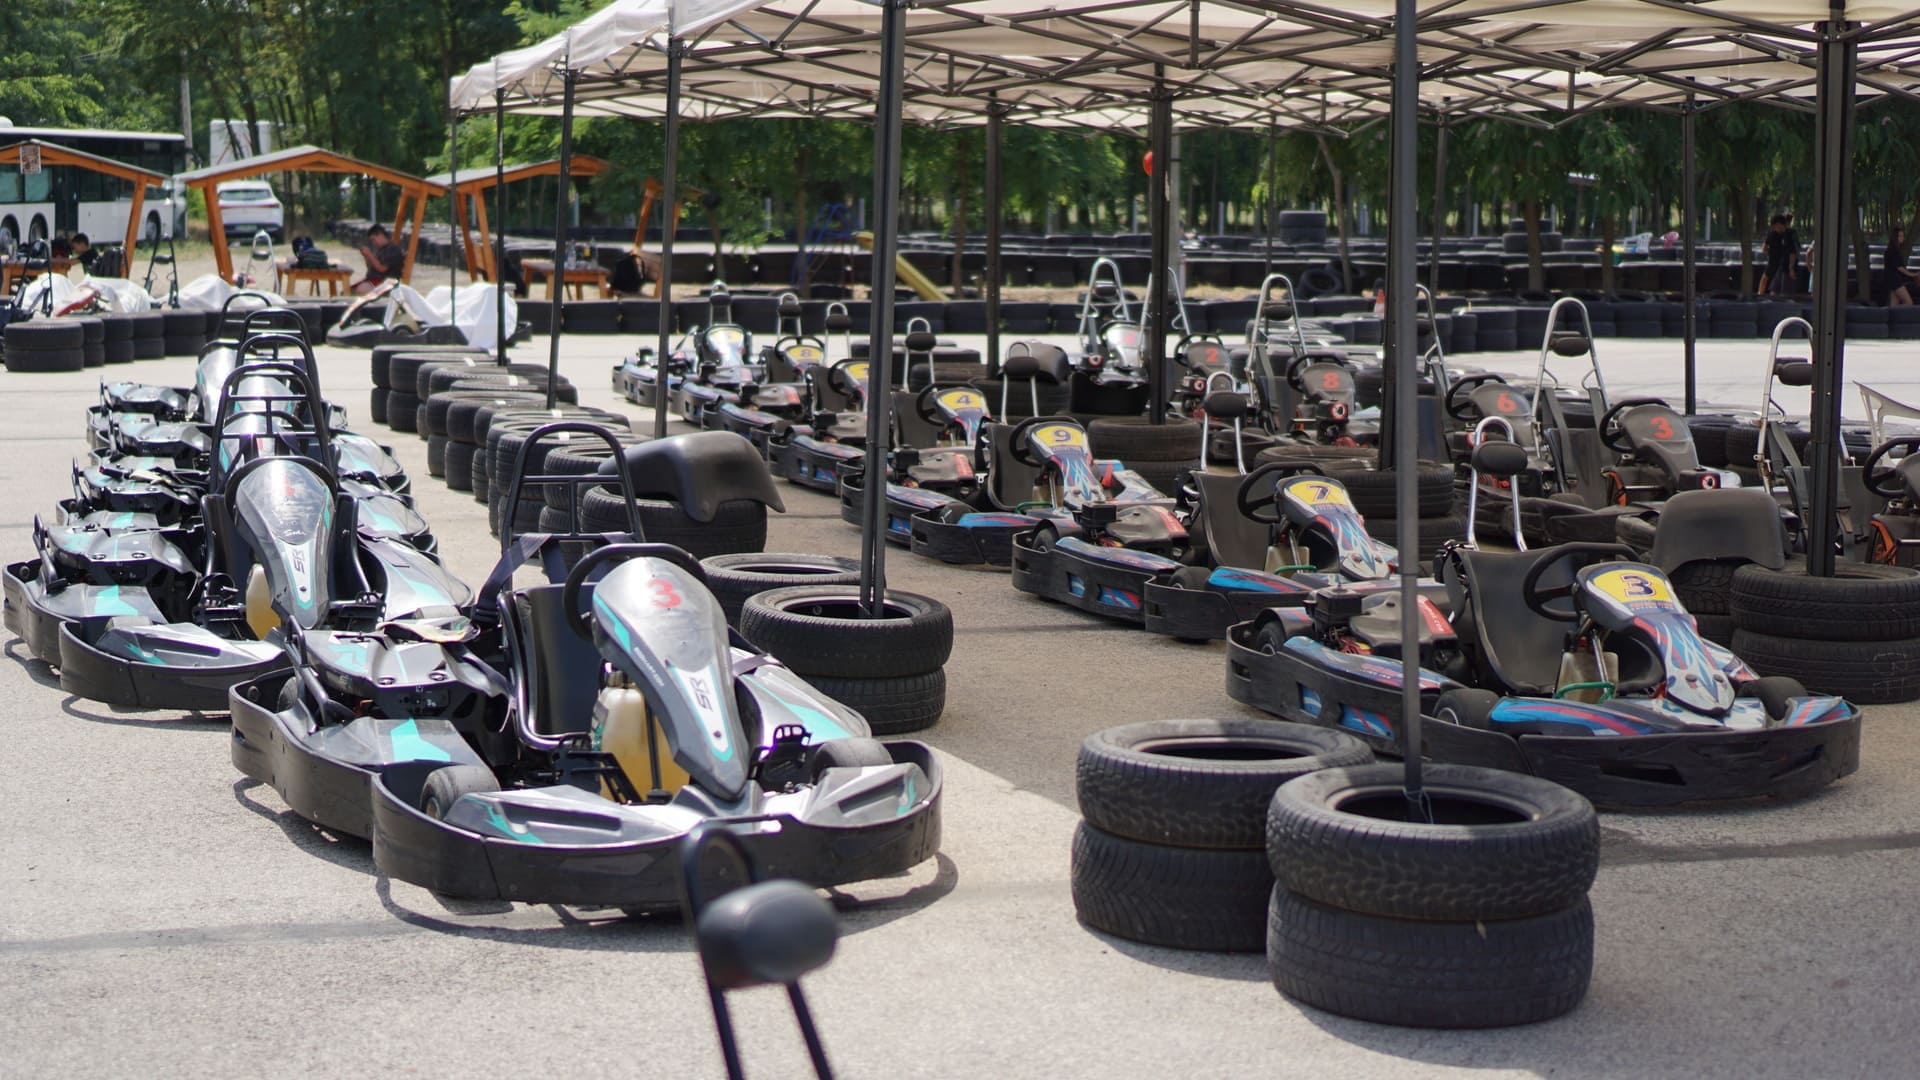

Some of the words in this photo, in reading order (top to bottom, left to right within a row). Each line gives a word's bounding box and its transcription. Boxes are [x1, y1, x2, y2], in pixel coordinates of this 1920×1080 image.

[1205, 347, 1218, 362] 2
[1322, 371, 1339, 389] 8
[956, 394, 971, 405] 4
[1496, 392, 1517, 413] 6
[1053, 429, 1072, 443] 9
[1650, 416, 1674, 440] 3
[1306, 484, 1331, 502] 7
[646, 578, 683, 609] 3
[1620, 573, 1656, 597] 3
